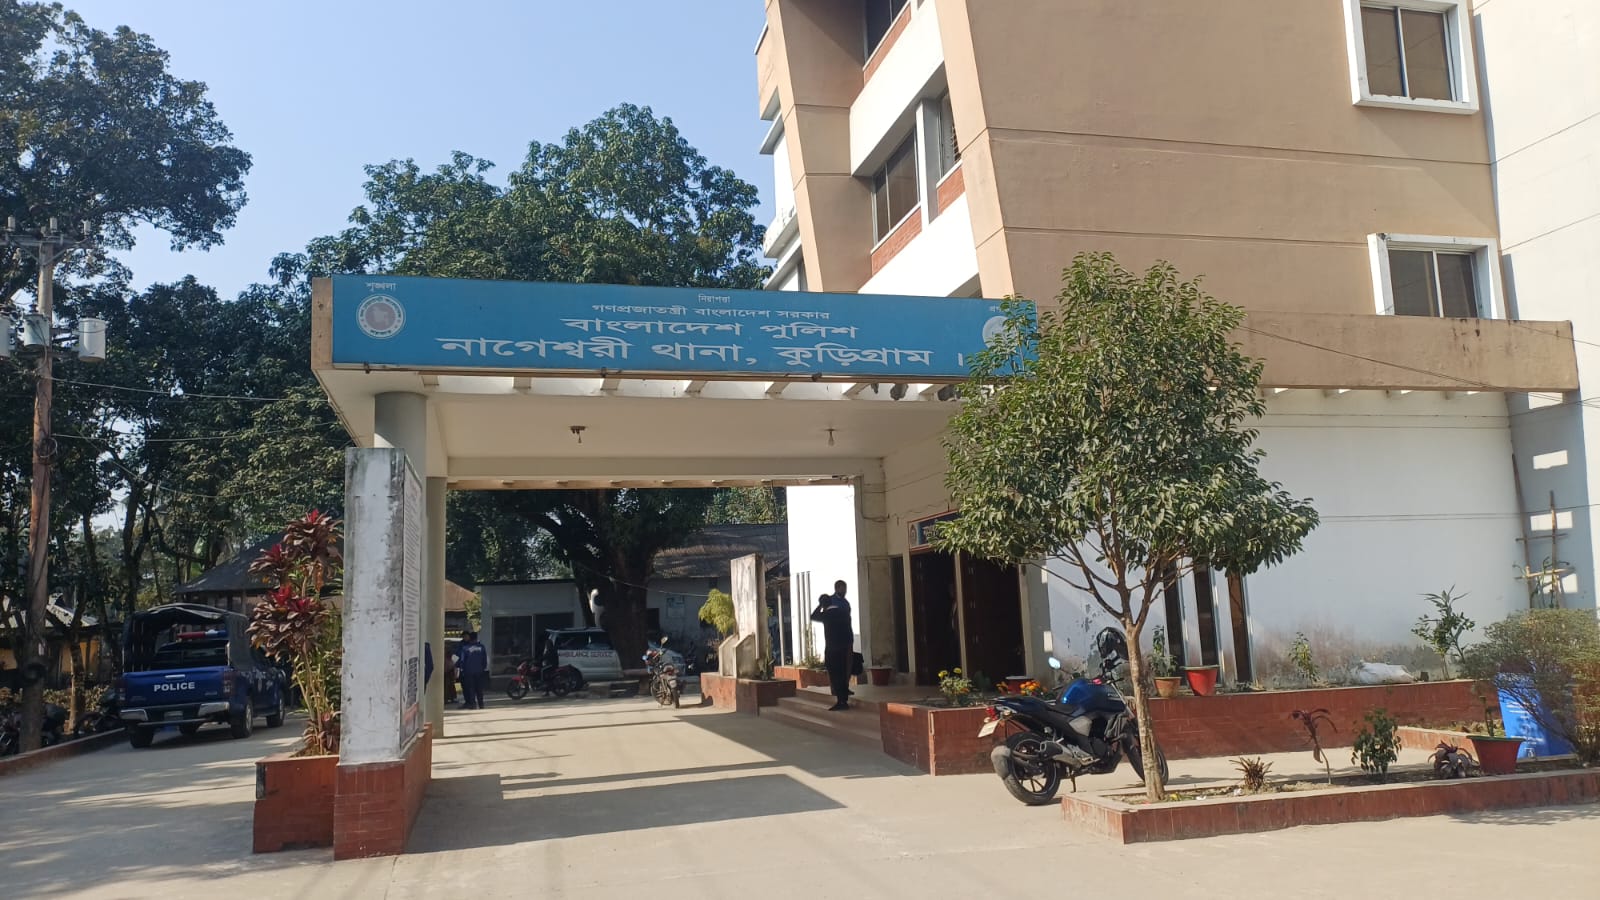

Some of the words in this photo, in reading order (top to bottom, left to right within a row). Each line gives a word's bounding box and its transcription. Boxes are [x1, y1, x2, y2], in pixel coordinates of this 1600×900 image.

[694, 308, 770, 318] বাংলাদেশ
[776, 310, 830, 320] সরকার
[560, 318, 743, 336] বাংলাদেশ
[760, 322, 859, 340] পুলিশ
[435, 336, 635, 360] নাগেশ্বরী
[651, 341, 758, 366] থানা,
[771, 343, 934, 368] কুড়িগ্রাম
[153, 682, 196, 692] POLICE
